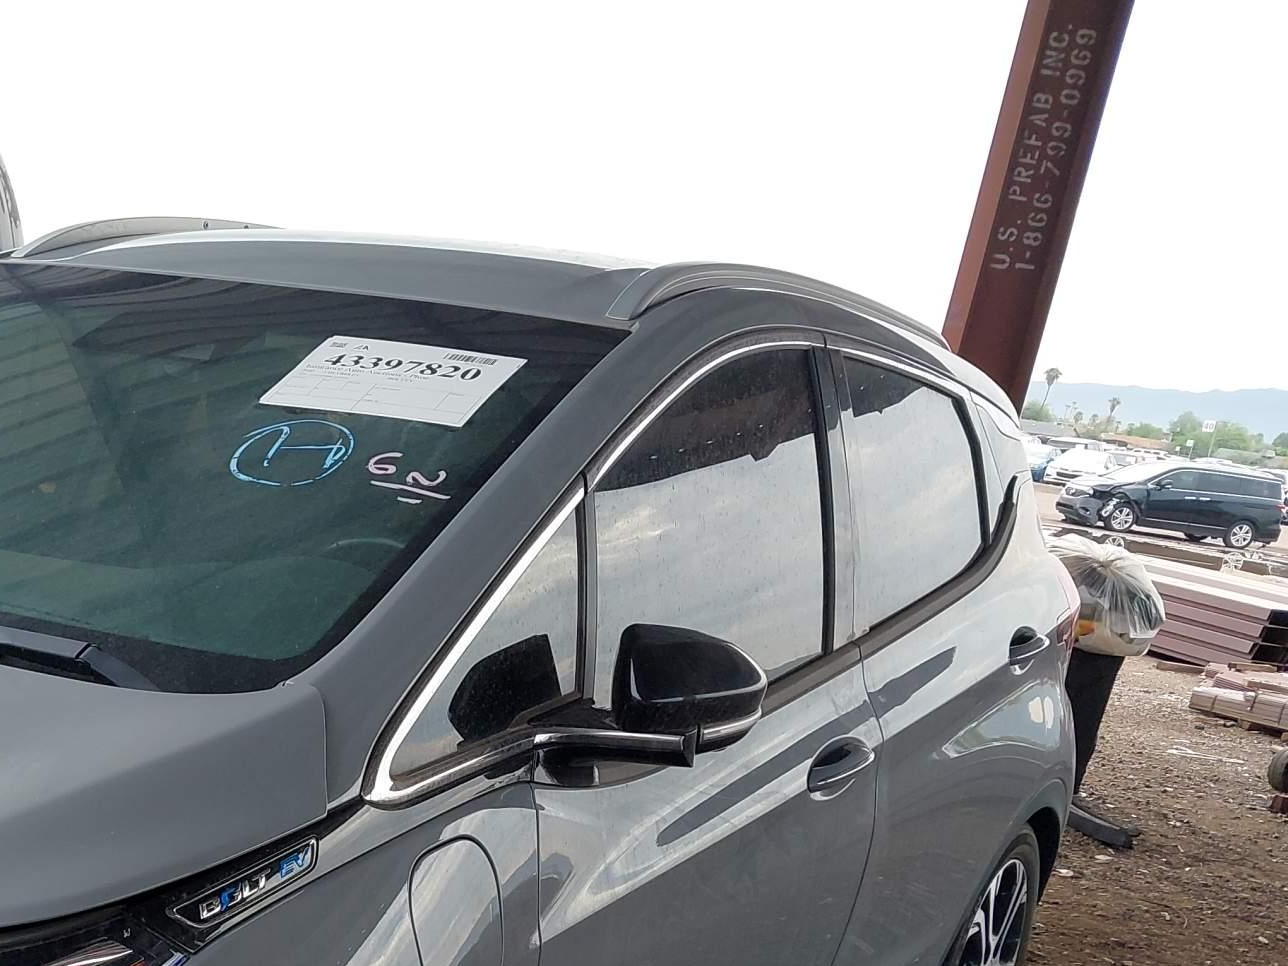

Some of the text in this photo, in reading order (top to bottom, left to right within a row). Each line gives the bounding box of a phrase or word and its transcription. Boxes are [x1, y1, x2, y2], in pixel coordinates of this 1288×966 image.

[1008, 92, 1053, 202] PREFAB
[1041, 24, 1073, 77] INC.
[1015, 28, 1097, 270] 1-866-799-0969
[324, 353, 481, 381] 43397820
[199, 846, 310, 919] BOLT EV
